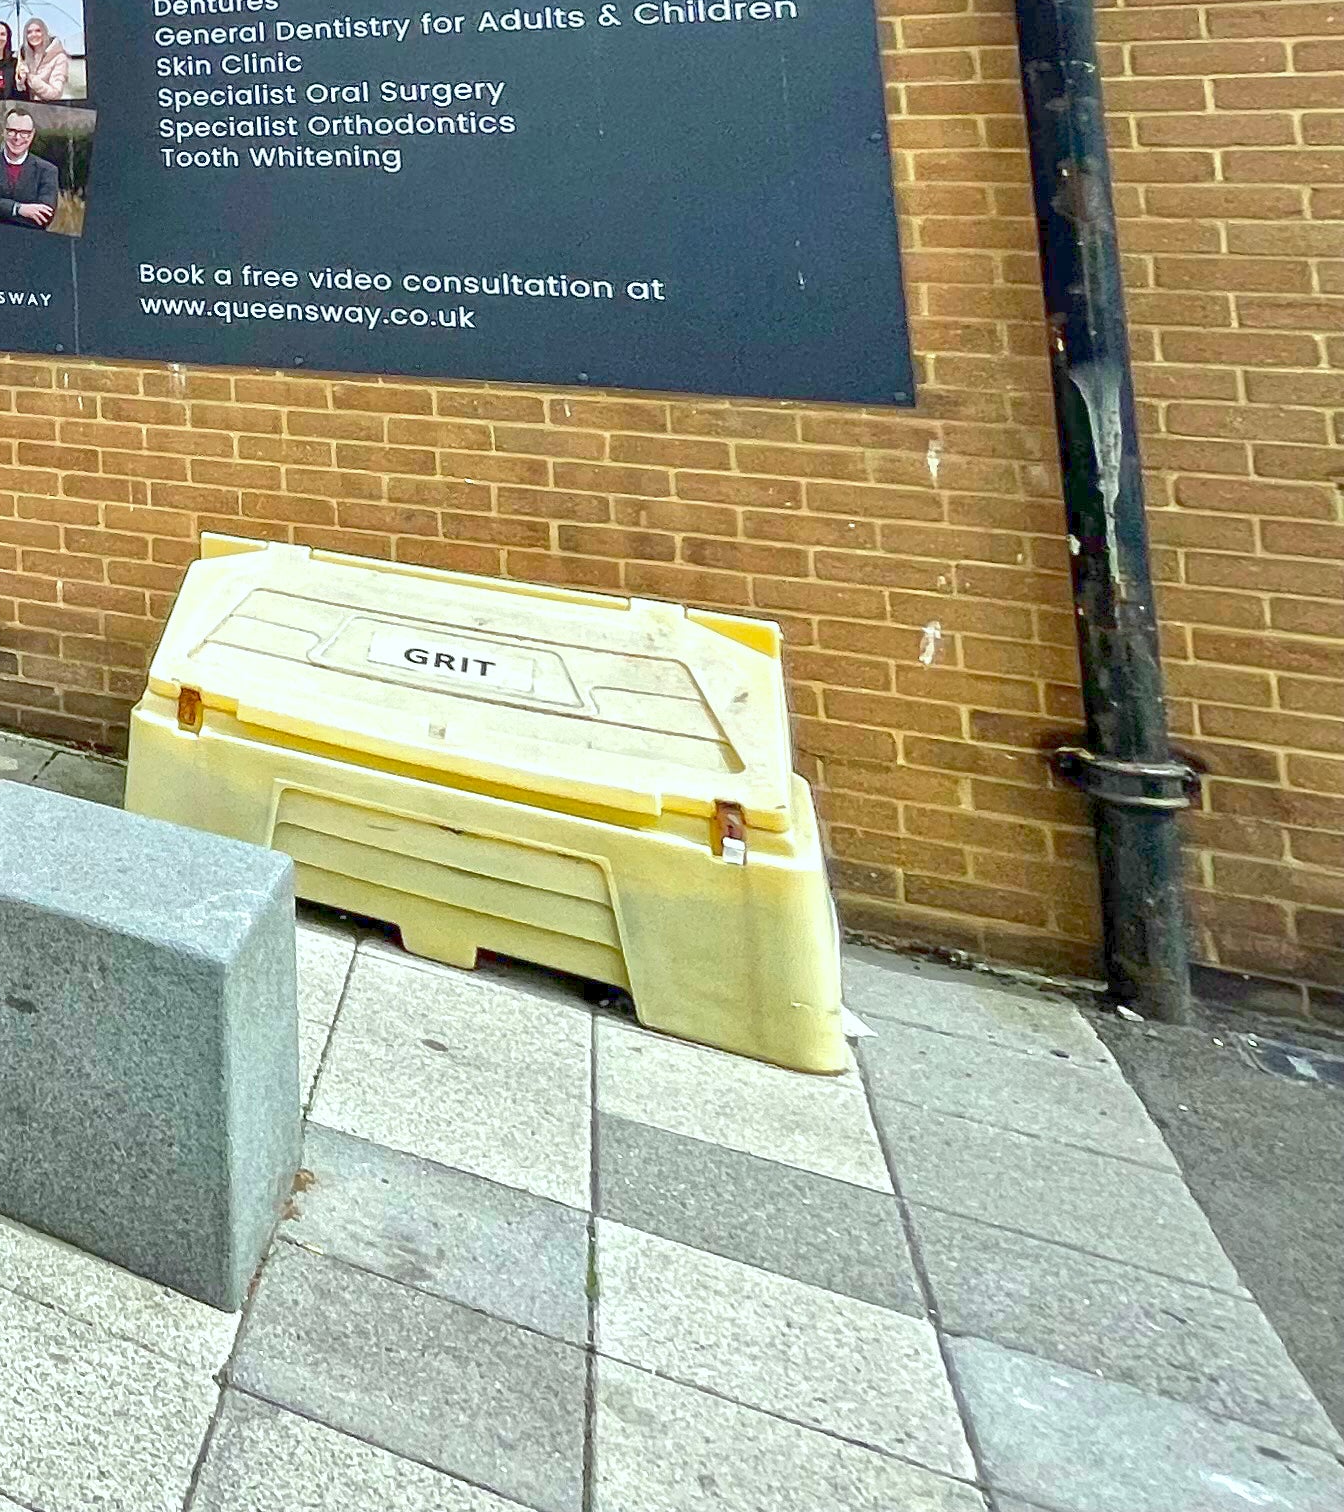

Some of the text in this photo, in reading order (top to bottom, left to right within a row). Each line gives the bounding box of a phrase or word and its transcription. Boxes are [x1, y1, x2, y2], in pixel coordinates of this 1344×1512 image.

[155, 21, 264, 46] General
[276, 15, 410, 41] Dentistry
[421, 11, 464, 35] for
[478, 7, 585, 33] Adults
[598, 3, 621, 27] &
[156, 52, 303, 77] Skin Clinic
[158, 80, 505, 112] Specialist Oral Surgery
[159, 111, 516, 143] Specialist Orthodontics
[161, 144, 402, 173] Tooth Whitening
[139, 263, 666, 302] Book a free video consultation at
[139, 296, 475, 330] www.queensway.co.uk
[403, 648, 496, 676] GRIT
